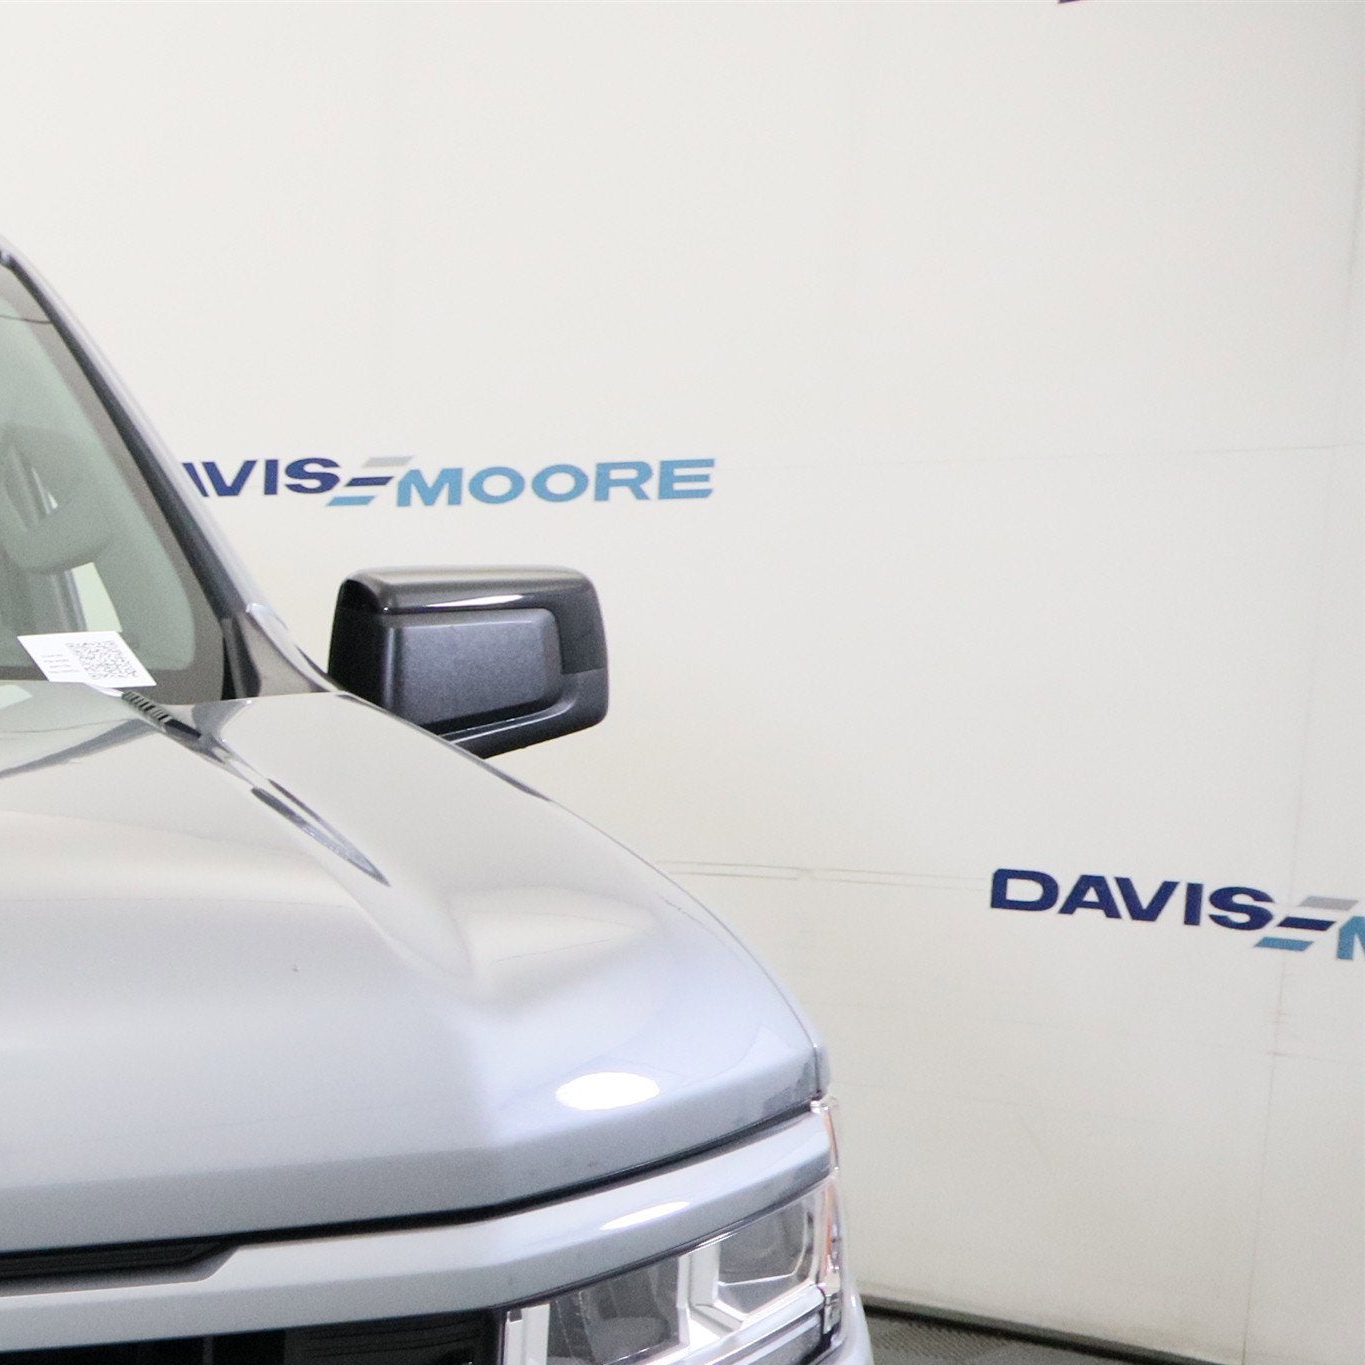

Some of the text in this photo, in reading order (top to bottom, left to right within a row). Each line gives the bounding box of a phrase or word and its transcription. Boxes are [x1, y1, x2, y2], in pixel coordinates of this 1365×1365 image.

[182, 457, 715, 508] VIS MOORE
[990, 867, 1276, 931] DAVIS
